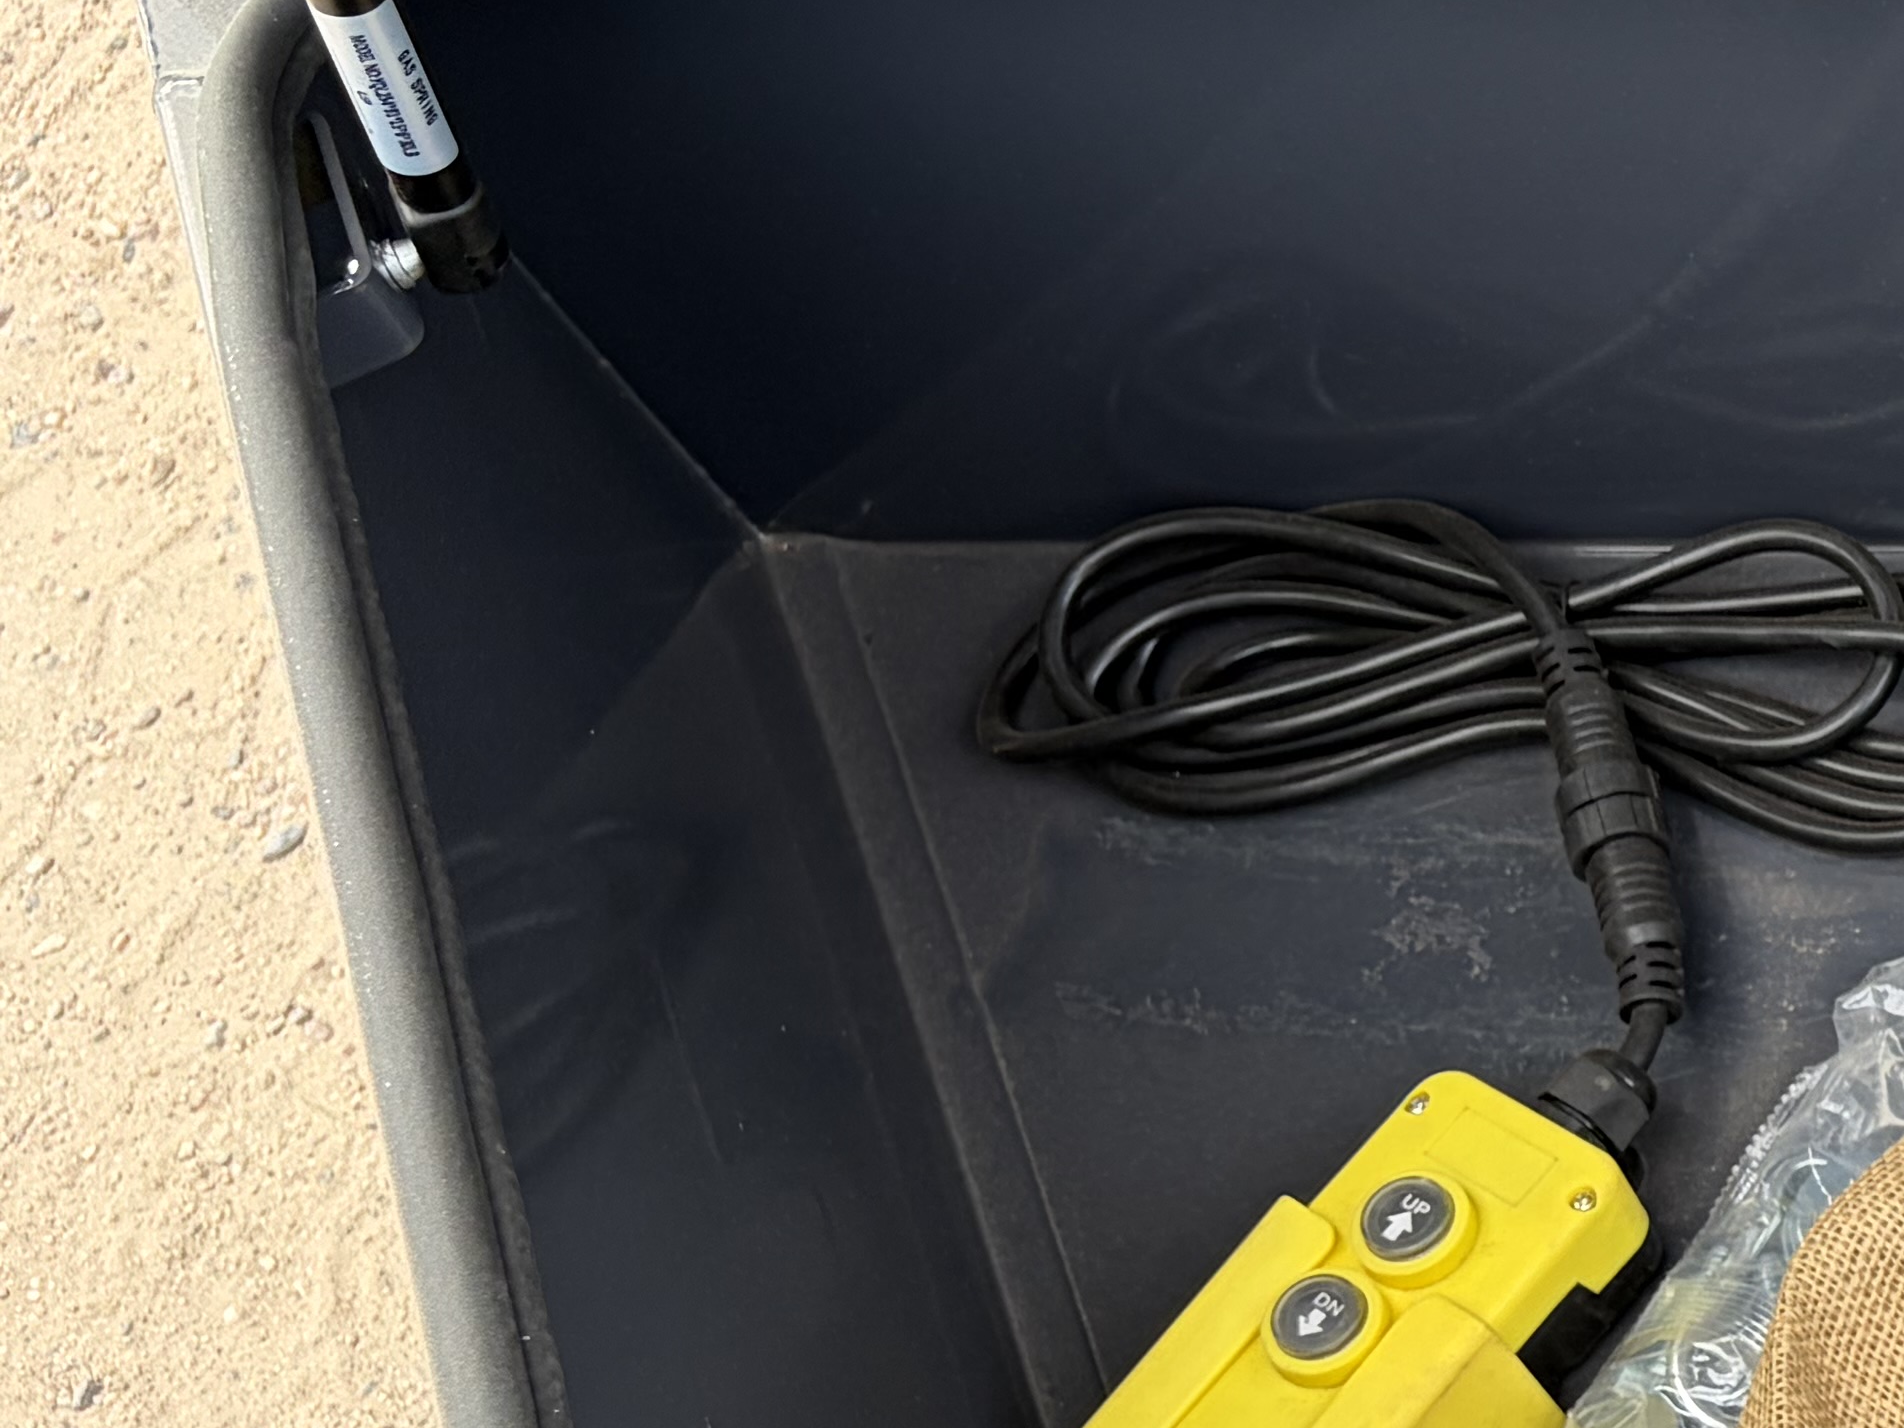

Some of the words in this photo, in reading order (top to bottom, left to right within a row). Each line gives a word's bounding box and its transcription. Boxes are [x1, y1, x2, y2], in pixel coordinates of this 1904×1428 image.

[398, 49, 414, 77] GAS
[411, 82, 438, 127] SPRING
[1401, 1191, 1432, 1215] UP
[1311, 1289, 1345, 1318] DN
